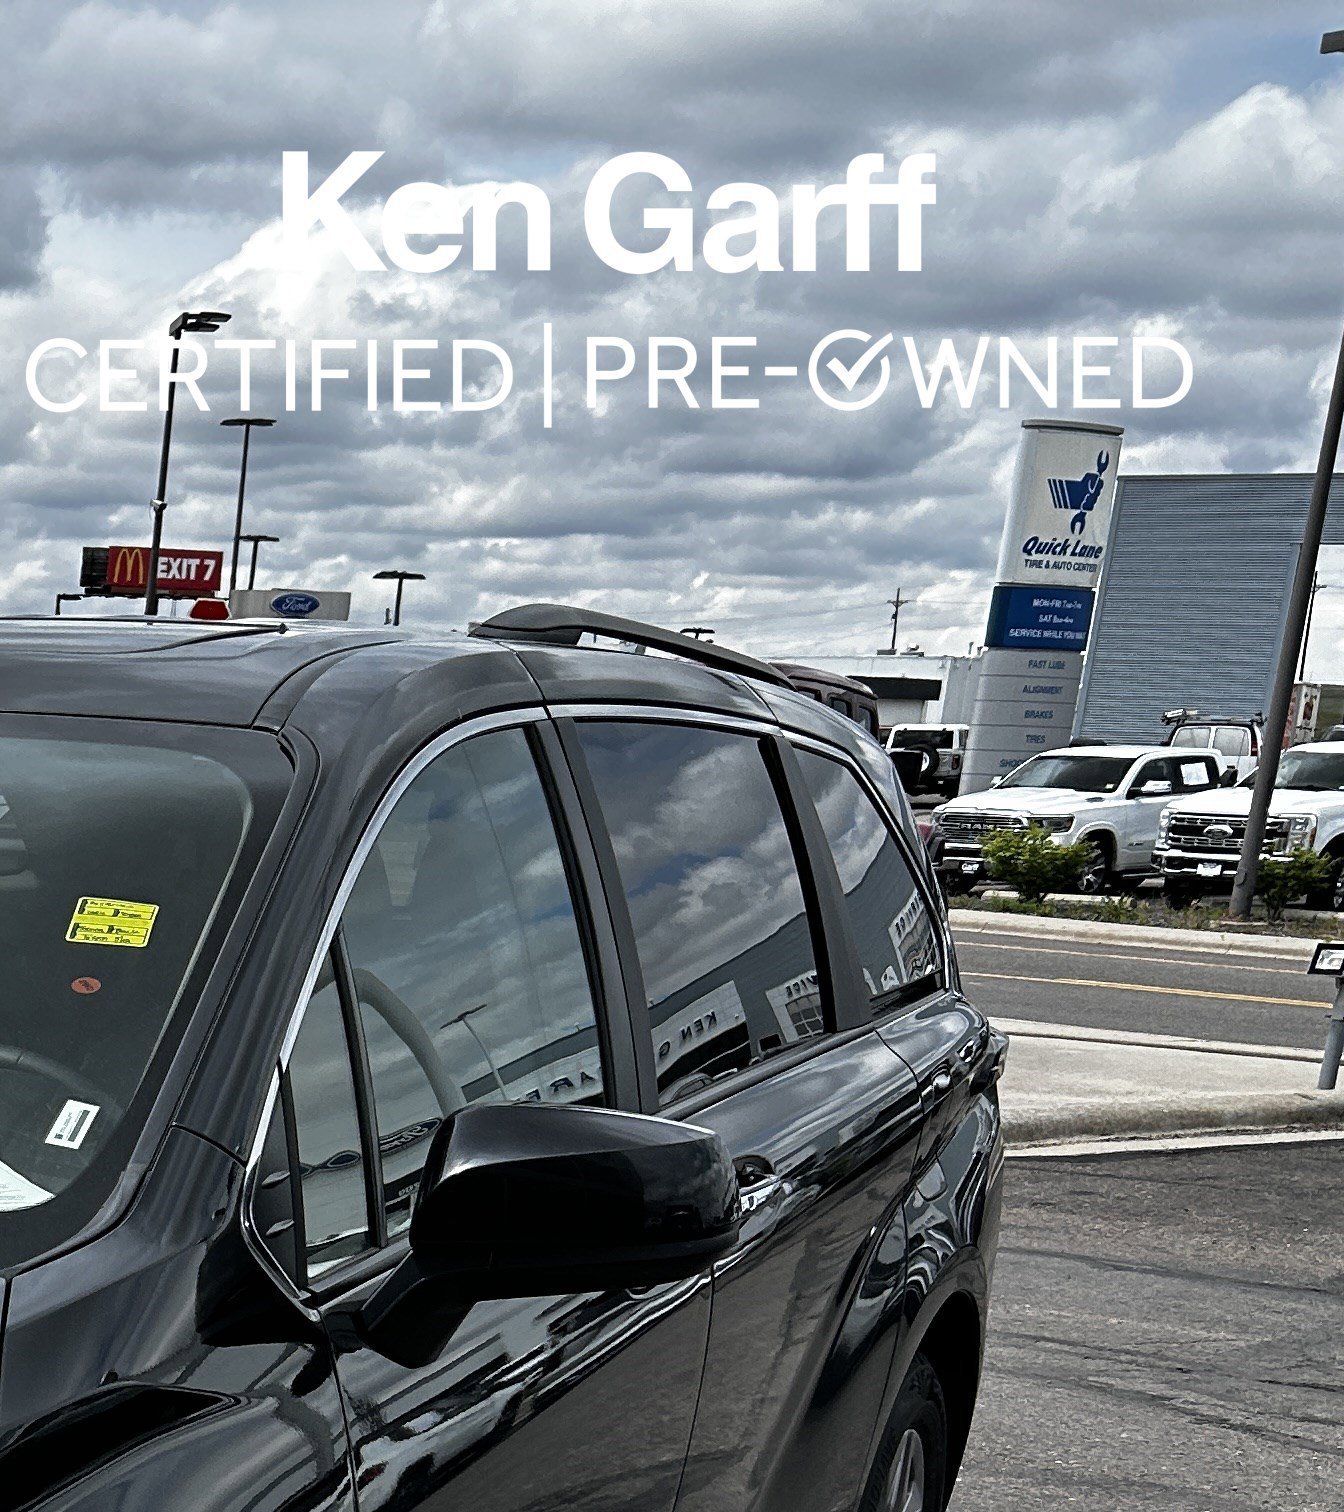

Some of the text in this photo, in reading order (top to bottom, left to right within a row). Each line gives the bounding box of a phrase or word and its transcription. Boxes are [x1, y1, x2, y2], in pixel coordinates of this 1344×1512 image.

[1023, 536, 1104, 559] Quick Lane
[156, 556, 200, 580] EXIT
[204, 559, 216, 581] 7
[1024, 558, 1044, 569] TIRE
[1052, 561, 1072, 570] AUTO
[1073, 562, 1098, 573] CENTER
[282, 596, 311, 611] Ford
[1008, 628, 1042, 638] SERVICE
[1027, 659, 1047, 669] FAST
[1022, 685, 1064, 695] ALIGNMENT
[1024, 710, 1054, 720] BRAKES
[1025, 735, 1046, 744] TIRES
